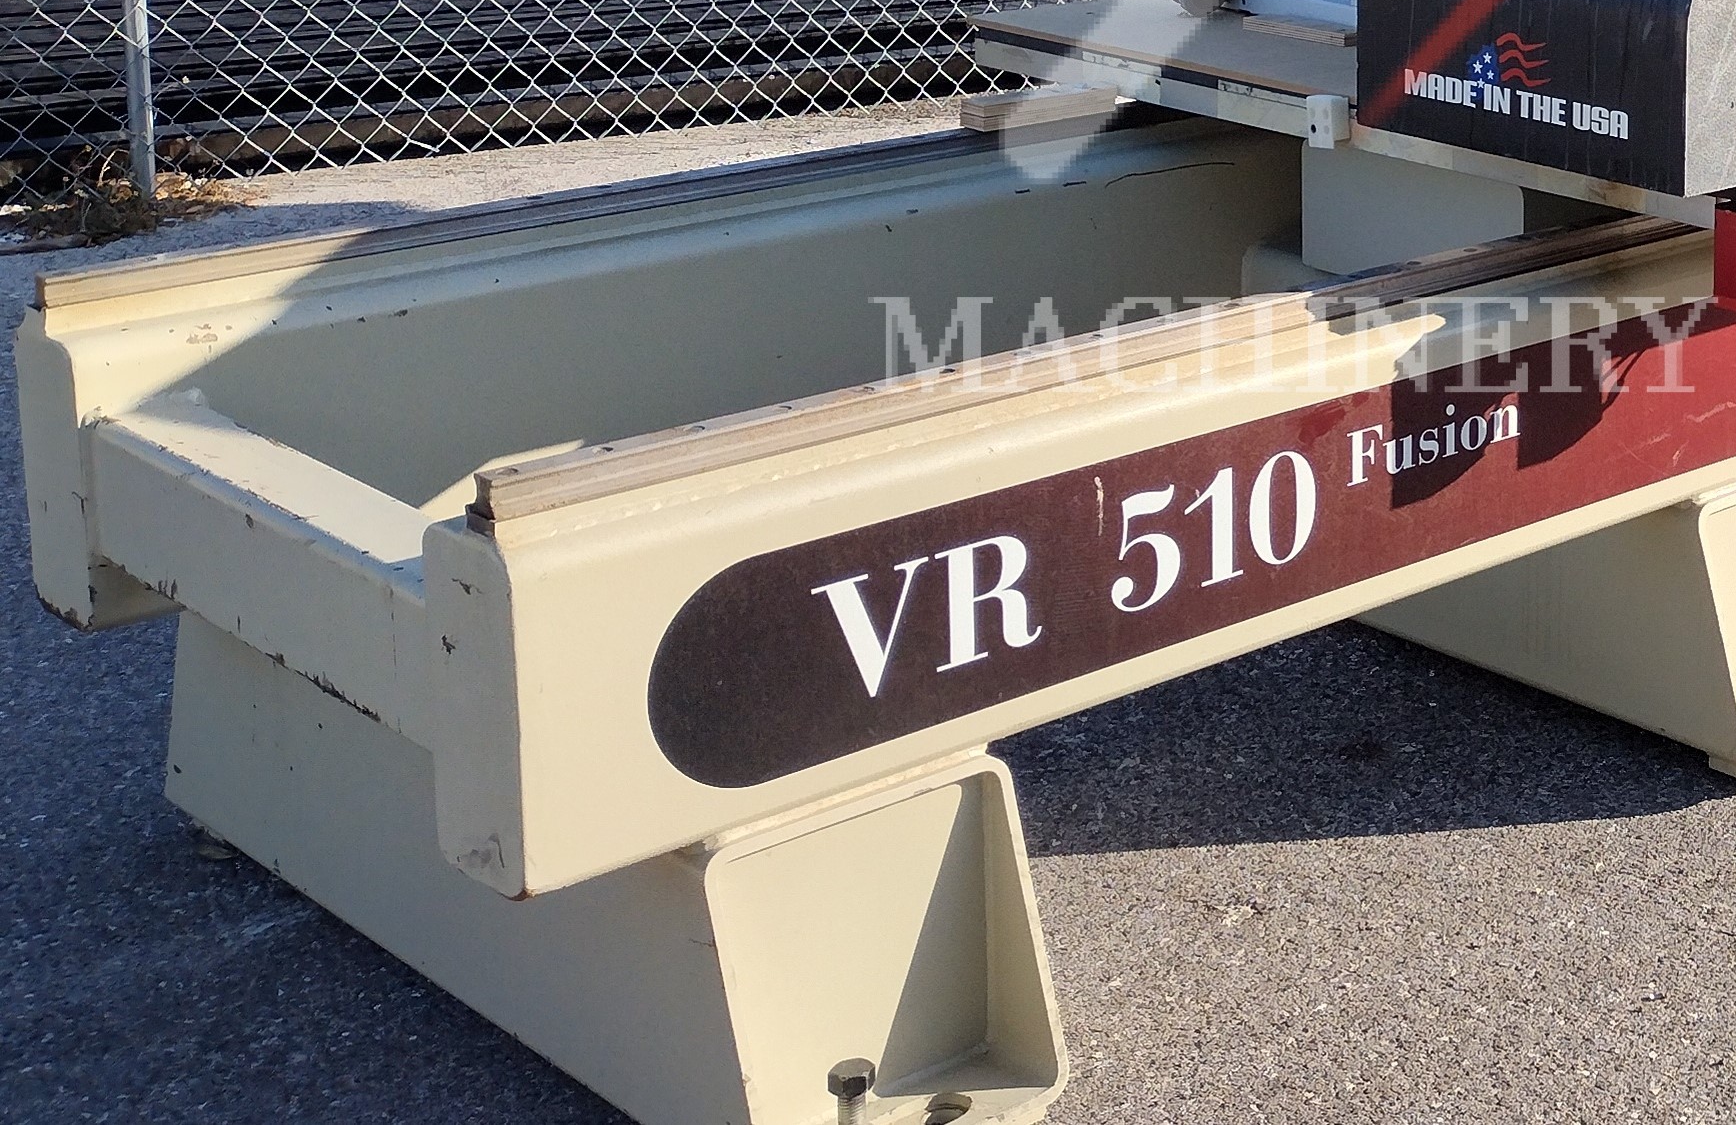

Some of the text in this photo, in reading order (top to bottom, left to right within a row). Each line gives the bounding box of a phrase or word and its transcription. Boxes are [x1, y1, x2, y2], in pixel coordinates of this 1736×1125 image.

[1404, 68, 1629, 140] MADE IN THE USA
[811, 403, 1522, 699] VR 510 Fusion
